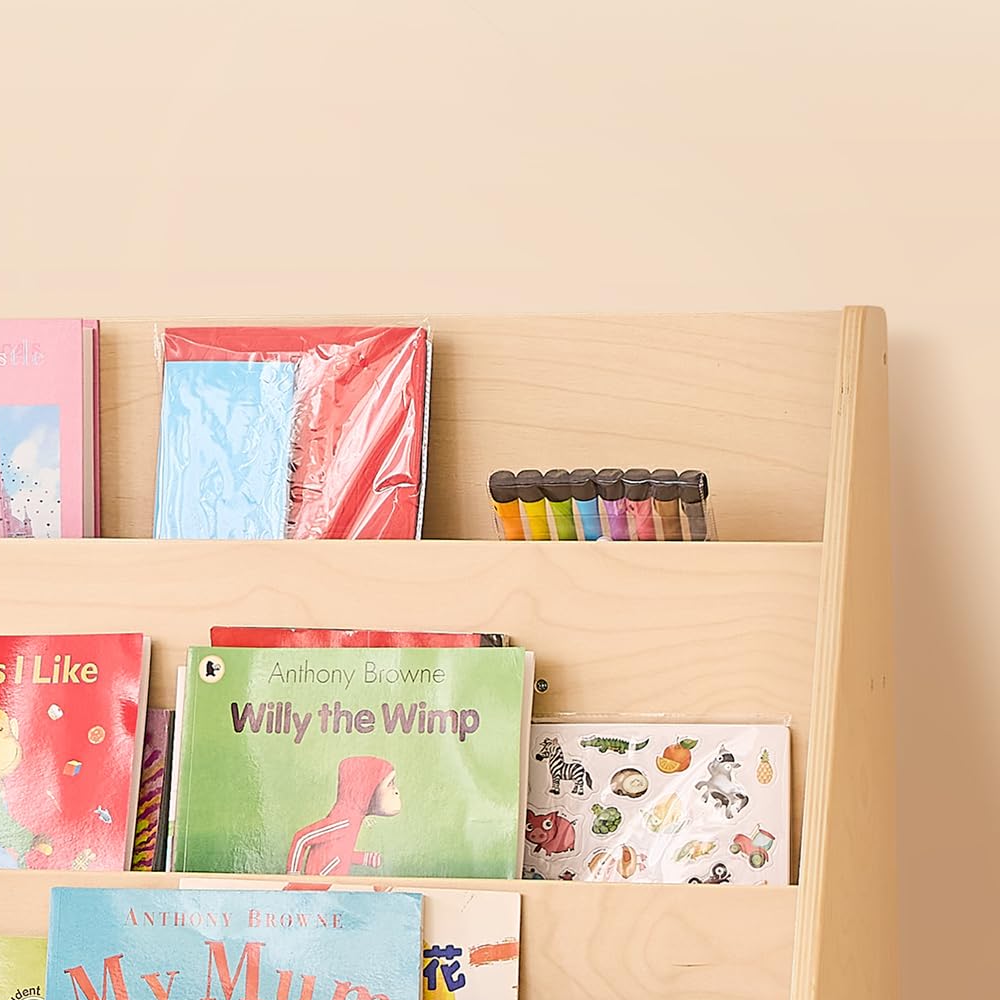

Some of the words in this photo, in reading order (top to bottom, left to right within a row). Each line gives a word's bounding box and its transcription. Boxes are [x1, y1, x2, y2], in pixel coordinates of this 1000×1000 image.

[13, 654, 25, 684] I
[32, 654, 99, 684] Like
[268, 660, 357, 690] Anthony
[364, 662, 446, 684] Browne
[230, 701, 313, 745] Willy
[317, 701, 376, 734] the
[381, 701, 481, 742] Wimp
[423, 944, 466, 992] 花
